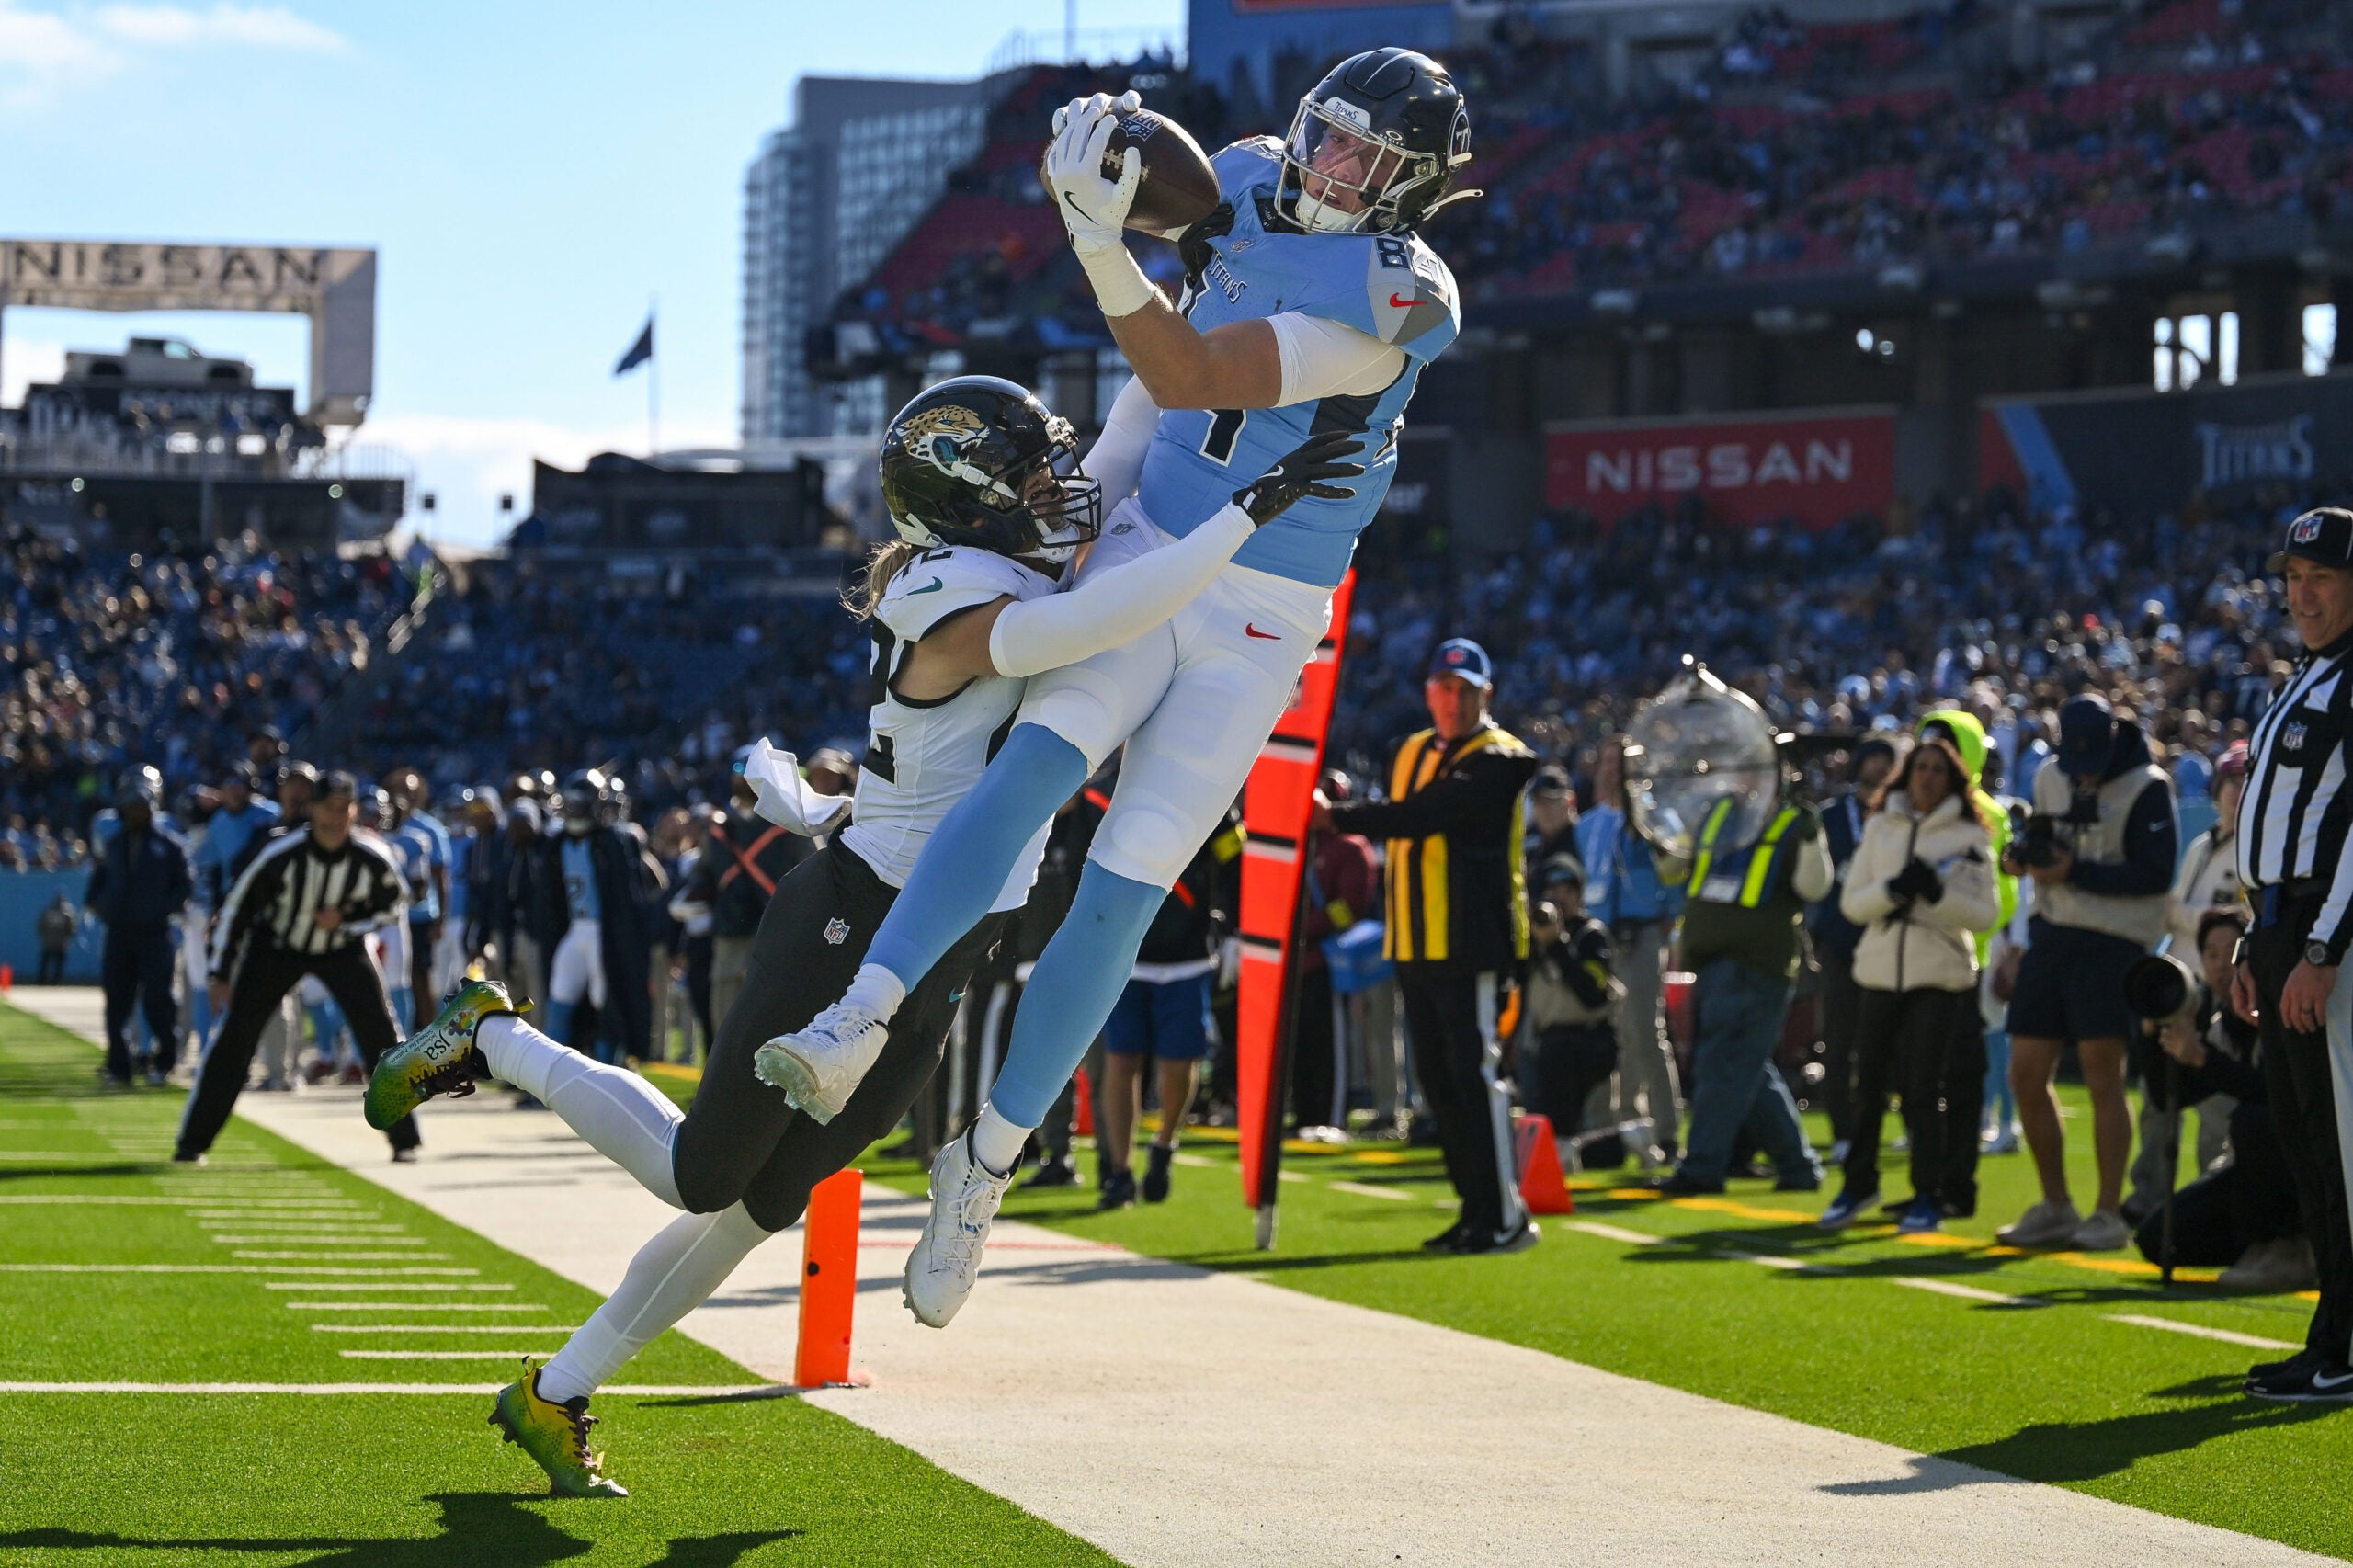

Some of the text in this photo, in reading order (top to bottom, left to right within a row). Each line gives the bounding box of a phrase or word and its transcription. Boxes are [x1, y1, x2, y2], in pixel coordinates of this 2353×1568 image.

[15, 244, 321, 287] NISSAN
[1209, 248, 1248, 304] TITANS
[1586, 438, 1853, 493] NISSAN
[424, 1029, 455, 1060] jsa
